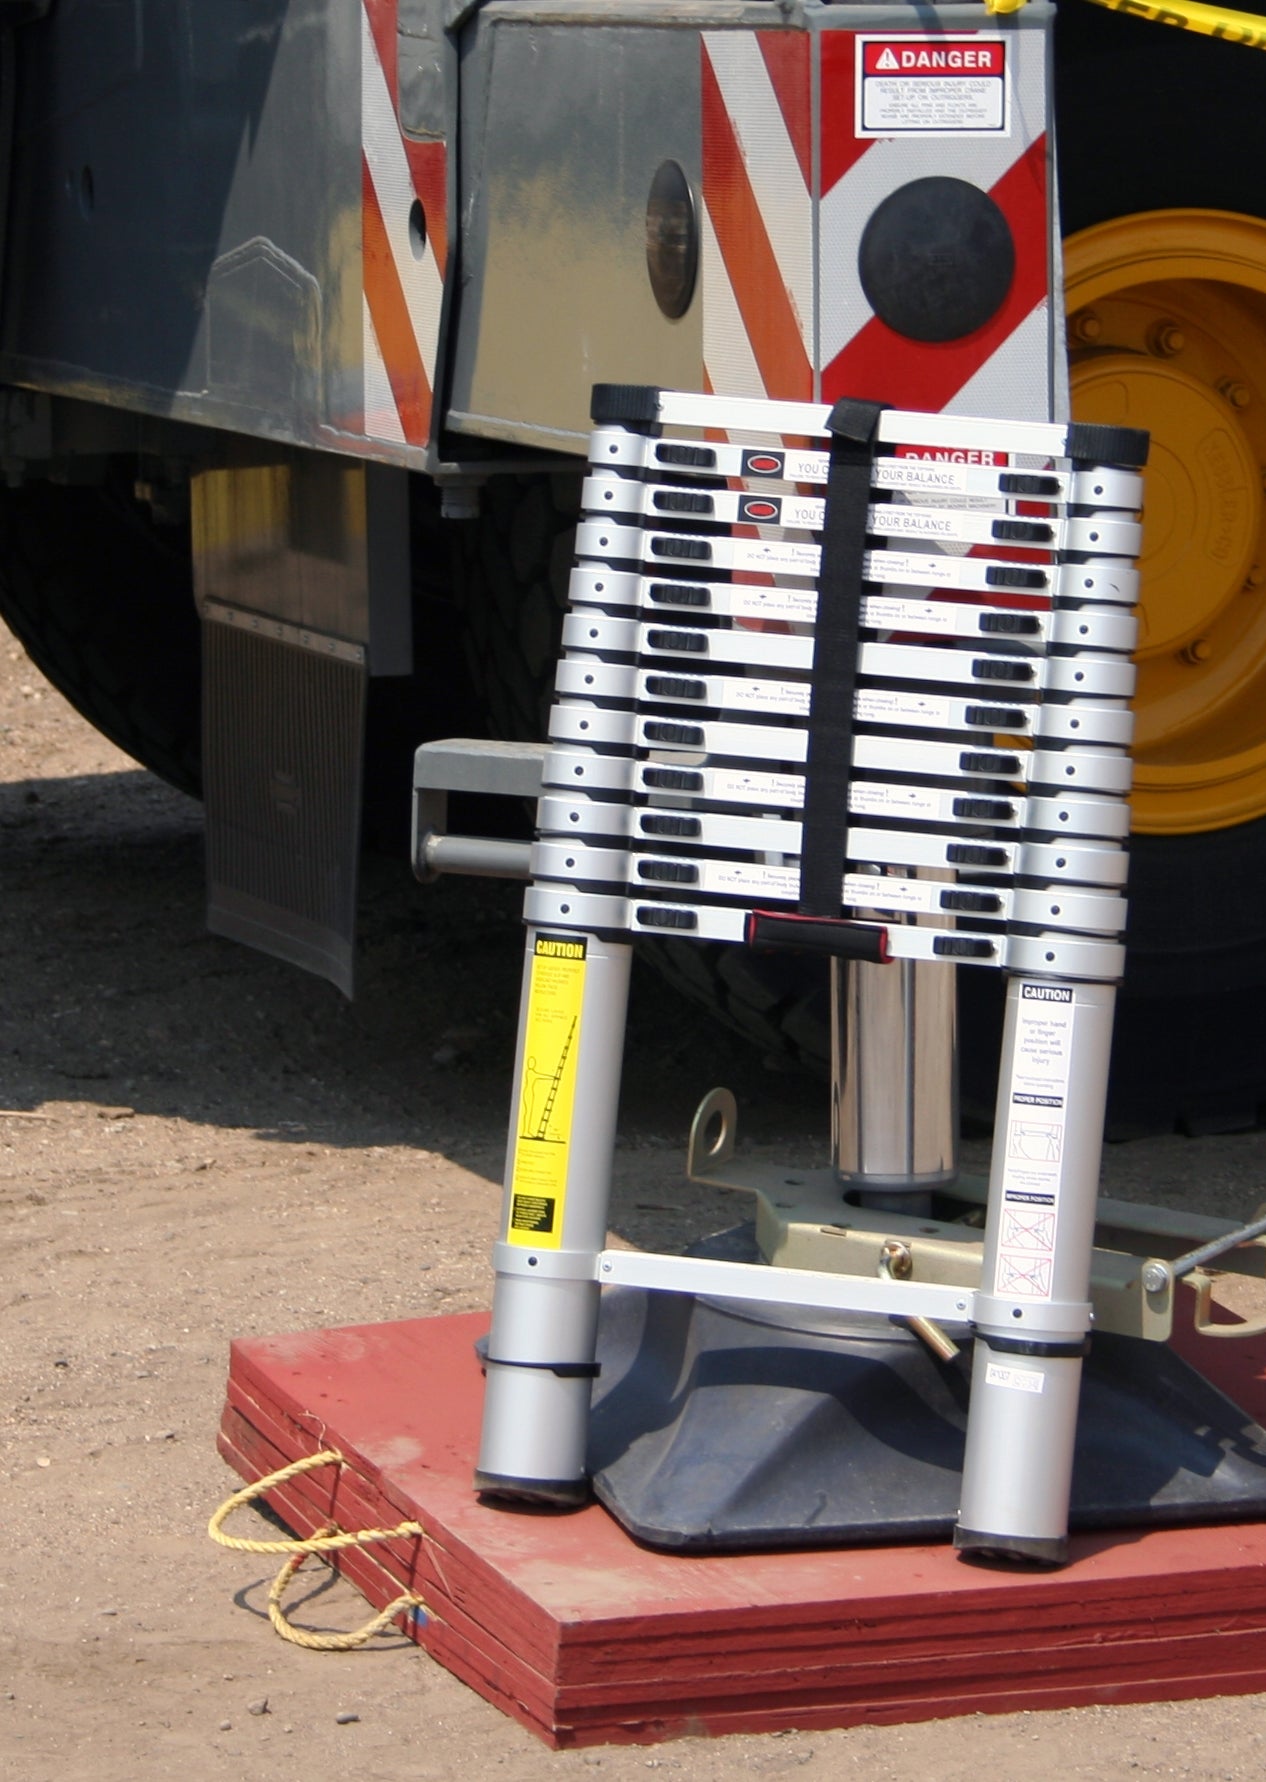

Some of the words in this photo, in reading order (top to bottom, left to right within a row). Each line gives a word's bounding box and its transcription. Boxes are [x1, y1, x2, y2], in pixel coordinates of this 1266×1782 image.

[901, 50, 992, 68] DANGER
[905, 451, 994, 466] DANGER
[798, 463, 819, 474] YOU
[875, 469, 903, 481] YOUR
[906, 471, 955, 485] BALANCE
[795, 509, 816, 520] YOU
[872, 515, 900, 527] YOUR
[903, 517, 952, 531] BALANCE
[536, 940, 584, 959] CAUTION
[1024, 986, 1070, 1001] CAUTION
